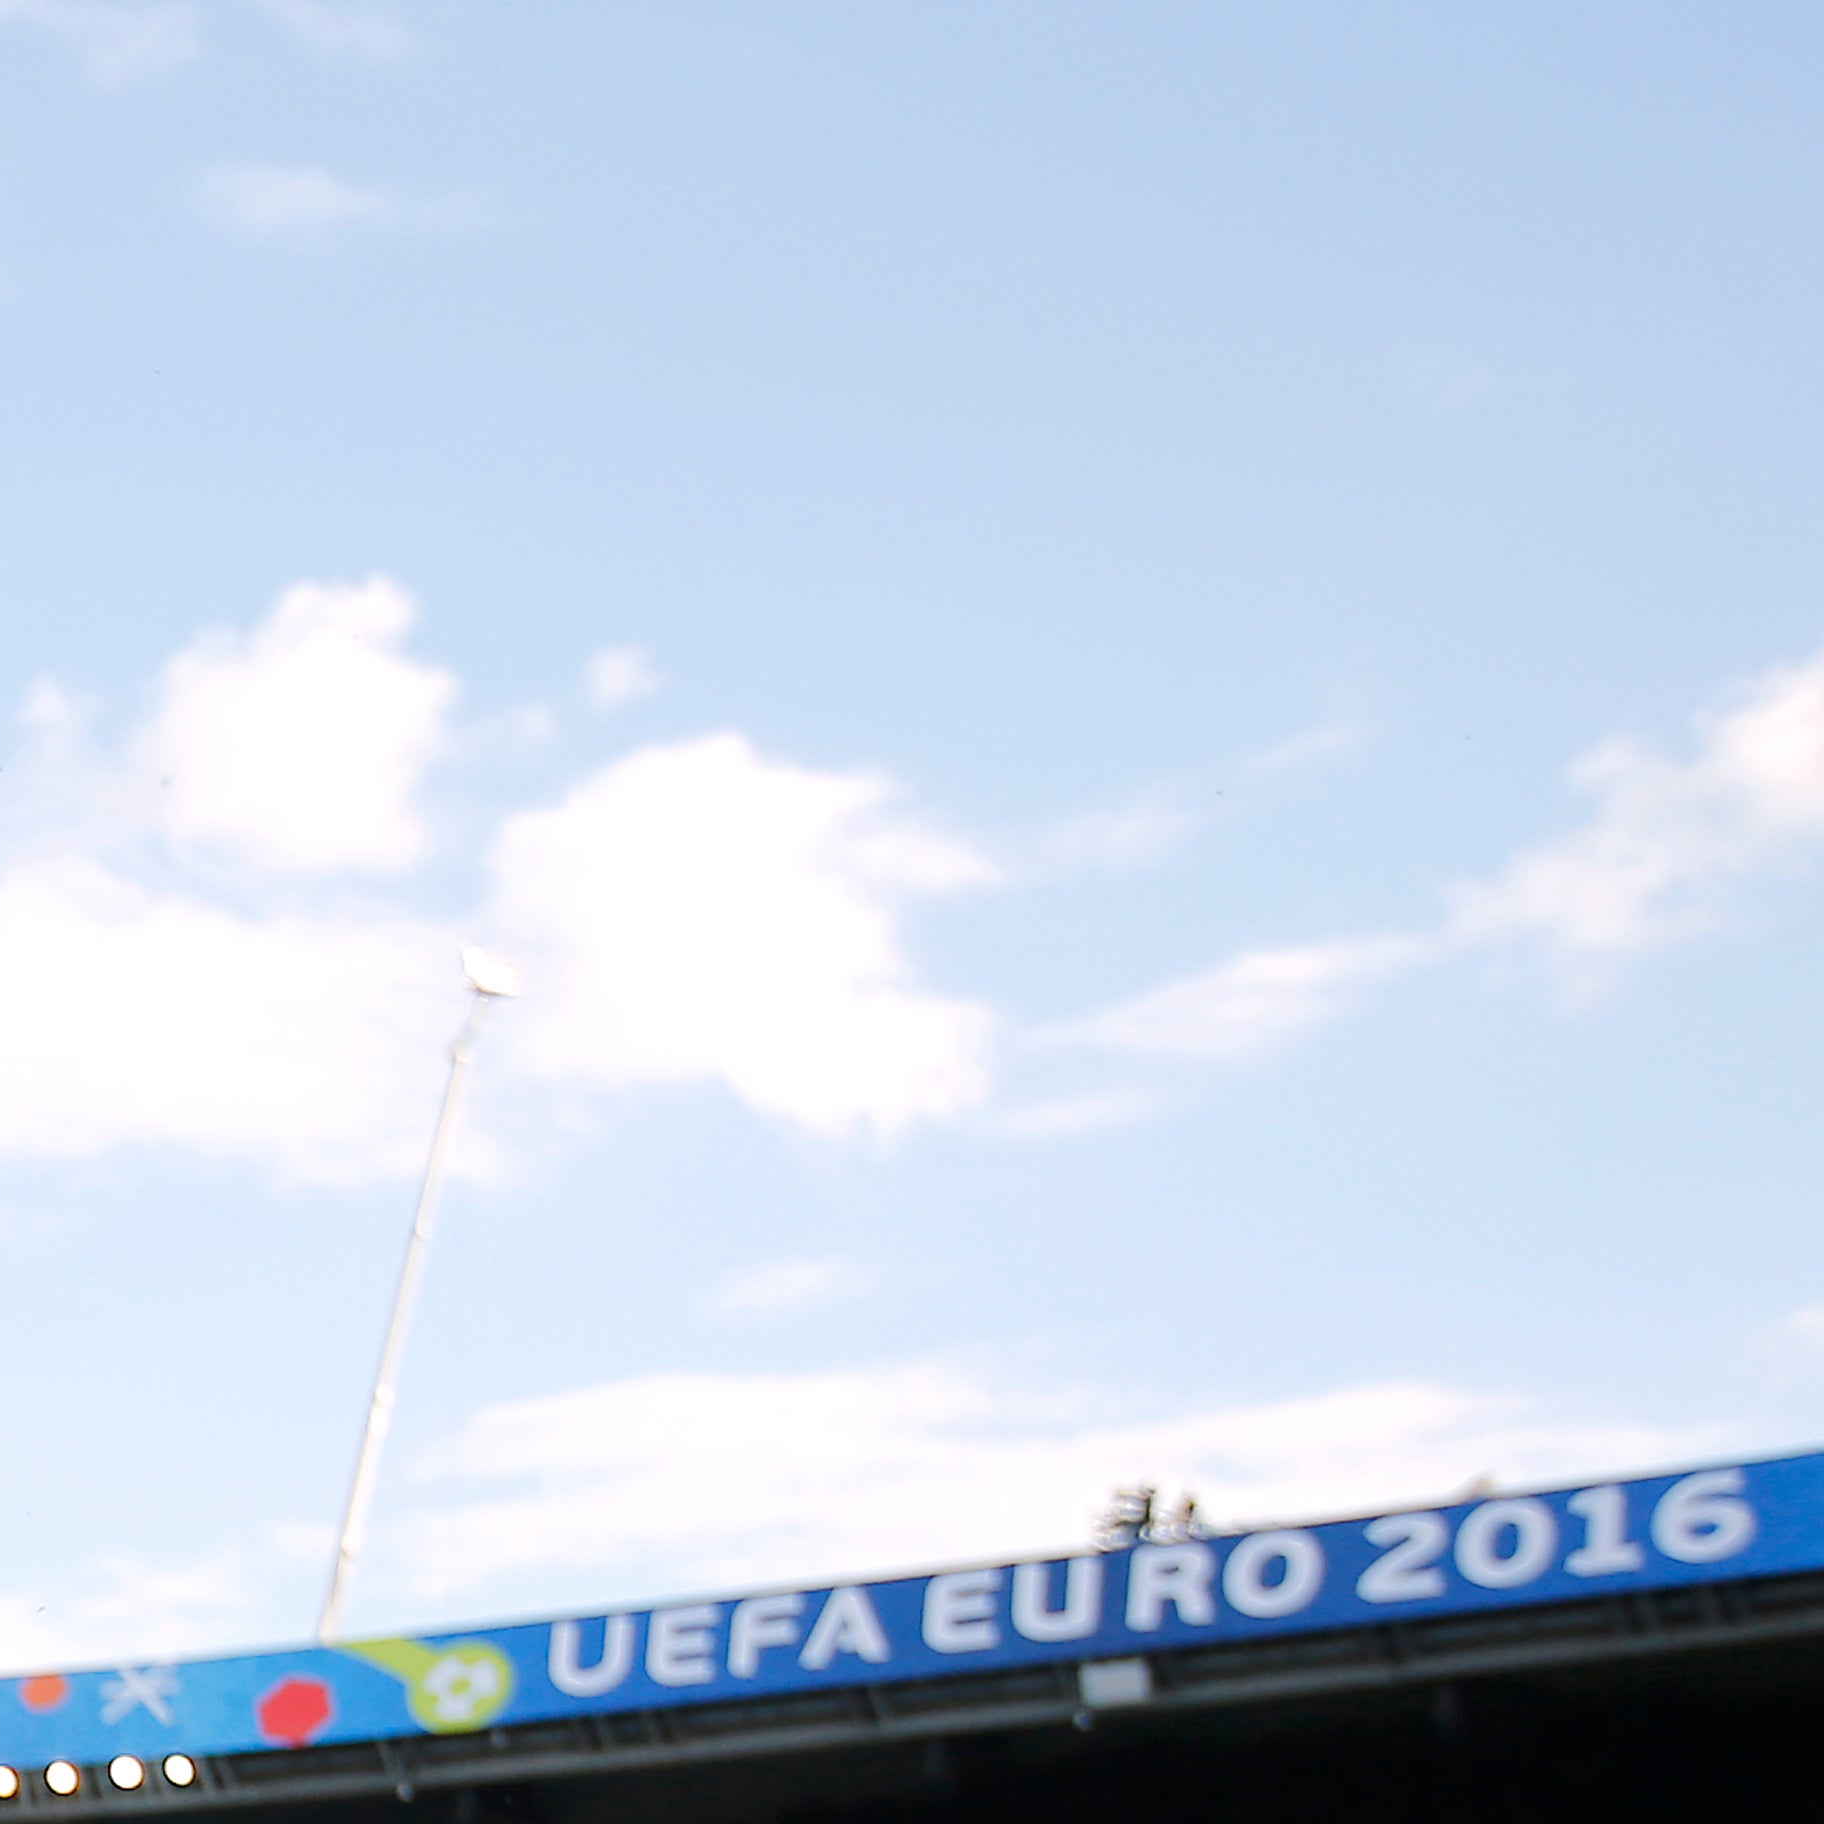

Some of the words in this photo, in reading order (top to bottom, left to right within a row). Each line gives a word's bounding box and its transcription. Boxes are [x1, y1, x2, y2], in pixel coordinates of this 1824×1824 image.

[547, 1585, 892, 1697] UEFA
[920, 1526, 1327, 1655] EURO
[1354, 1467, 1757, 1605] 2016
